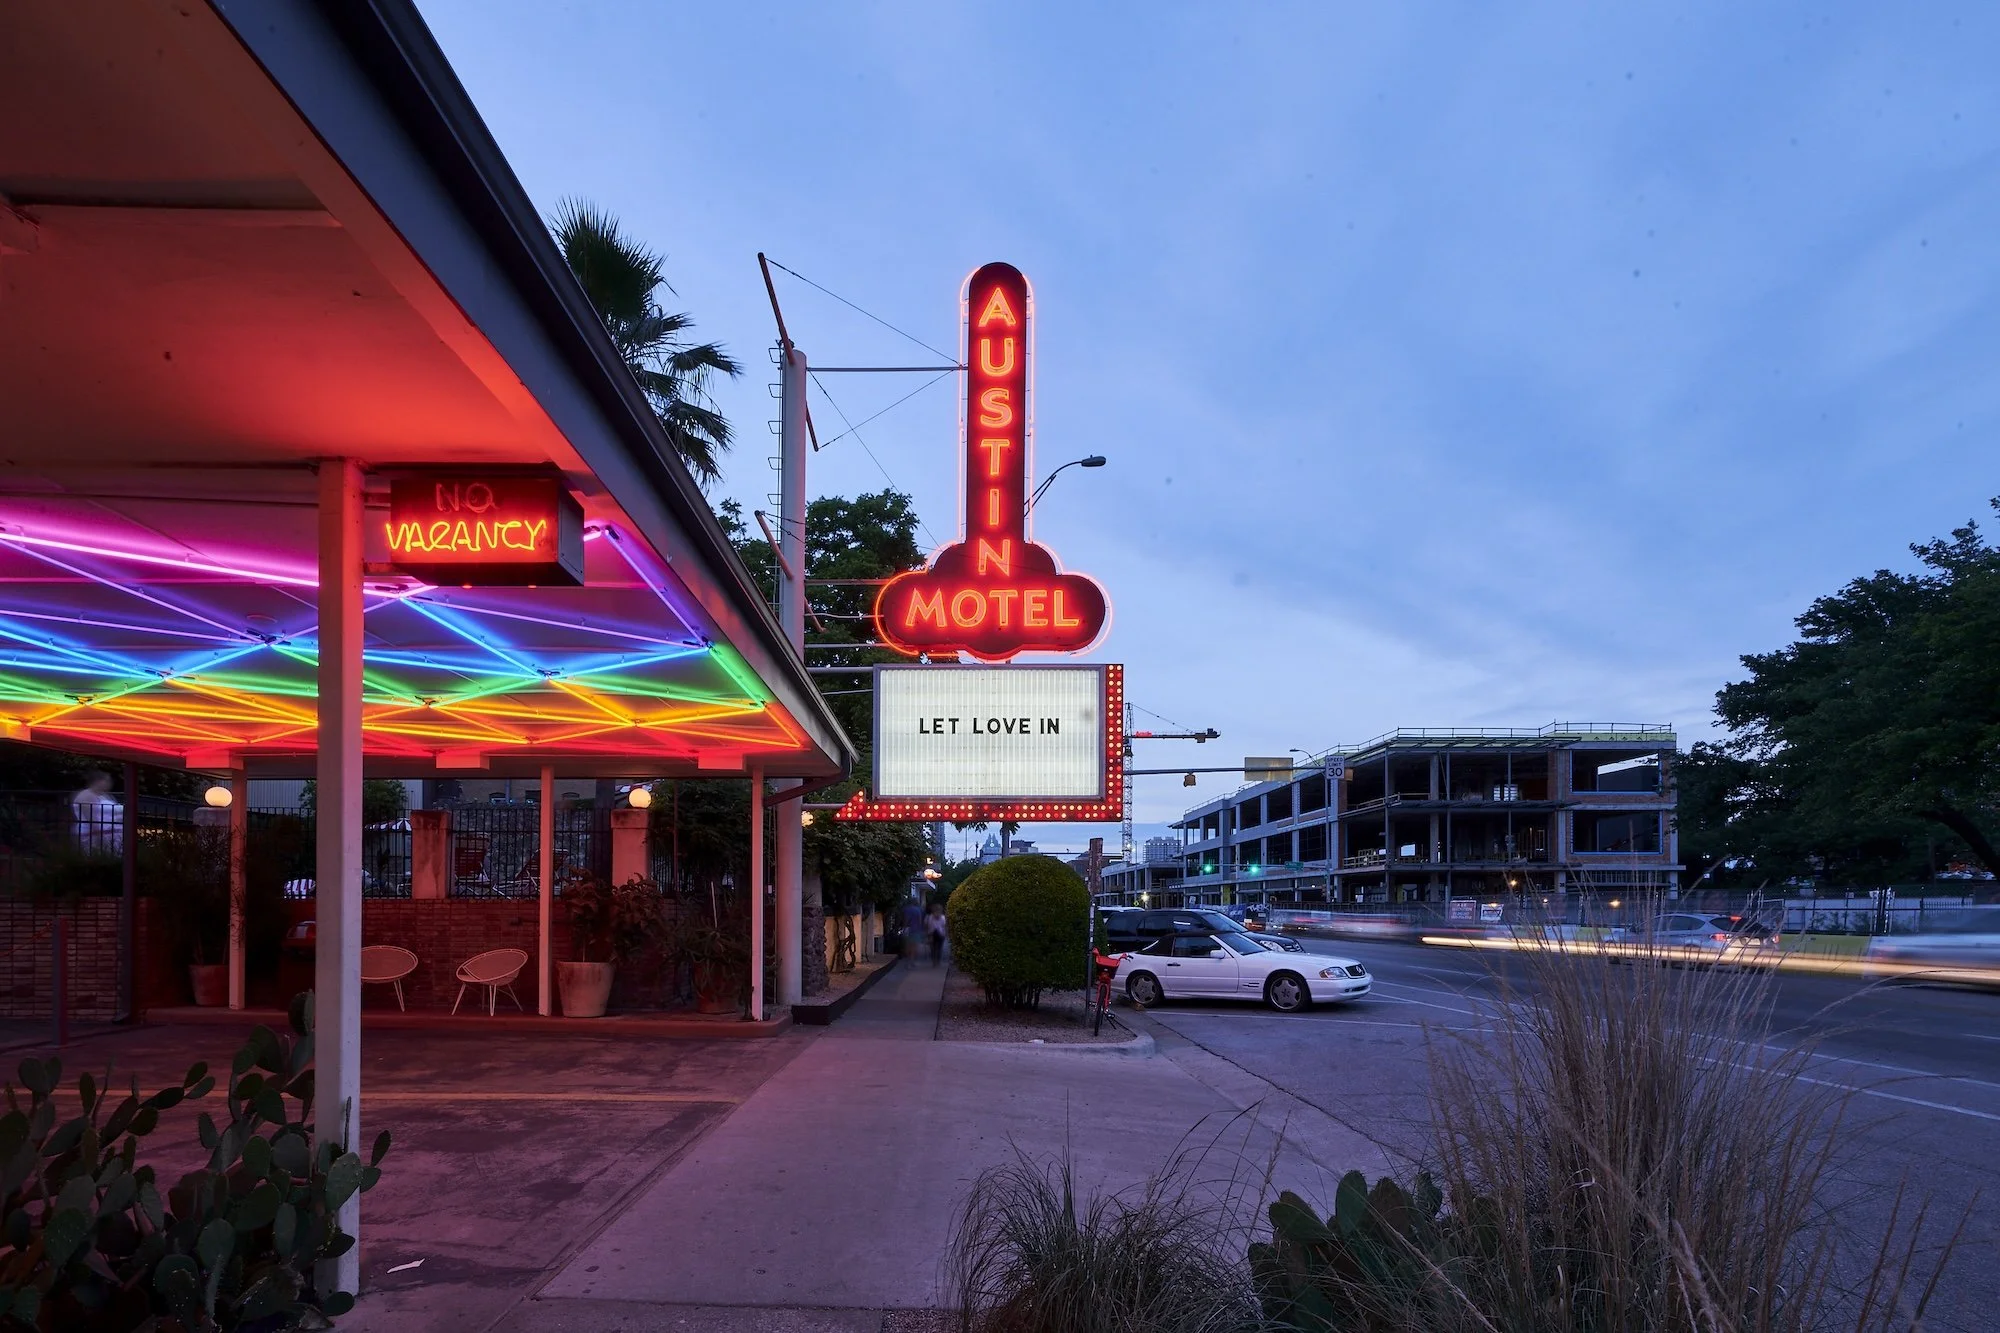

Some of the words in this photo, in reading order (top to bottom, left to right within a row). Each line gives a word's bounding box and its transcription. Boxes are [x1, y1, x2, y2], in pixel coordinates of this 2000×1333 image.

[978, 287, 1016, 577] AUSTIN
[436, 483, 497, 513] NO
[385, 519, 547, 552] VACANCY
[905, 587, 1080, 628] MOTEL
[919, 717, 959, 734] LET
[973, 717, 1031, 734] LOVE
[1040, 717, 1060, 734] IN
[1328, 767, 1343, 777] 30
